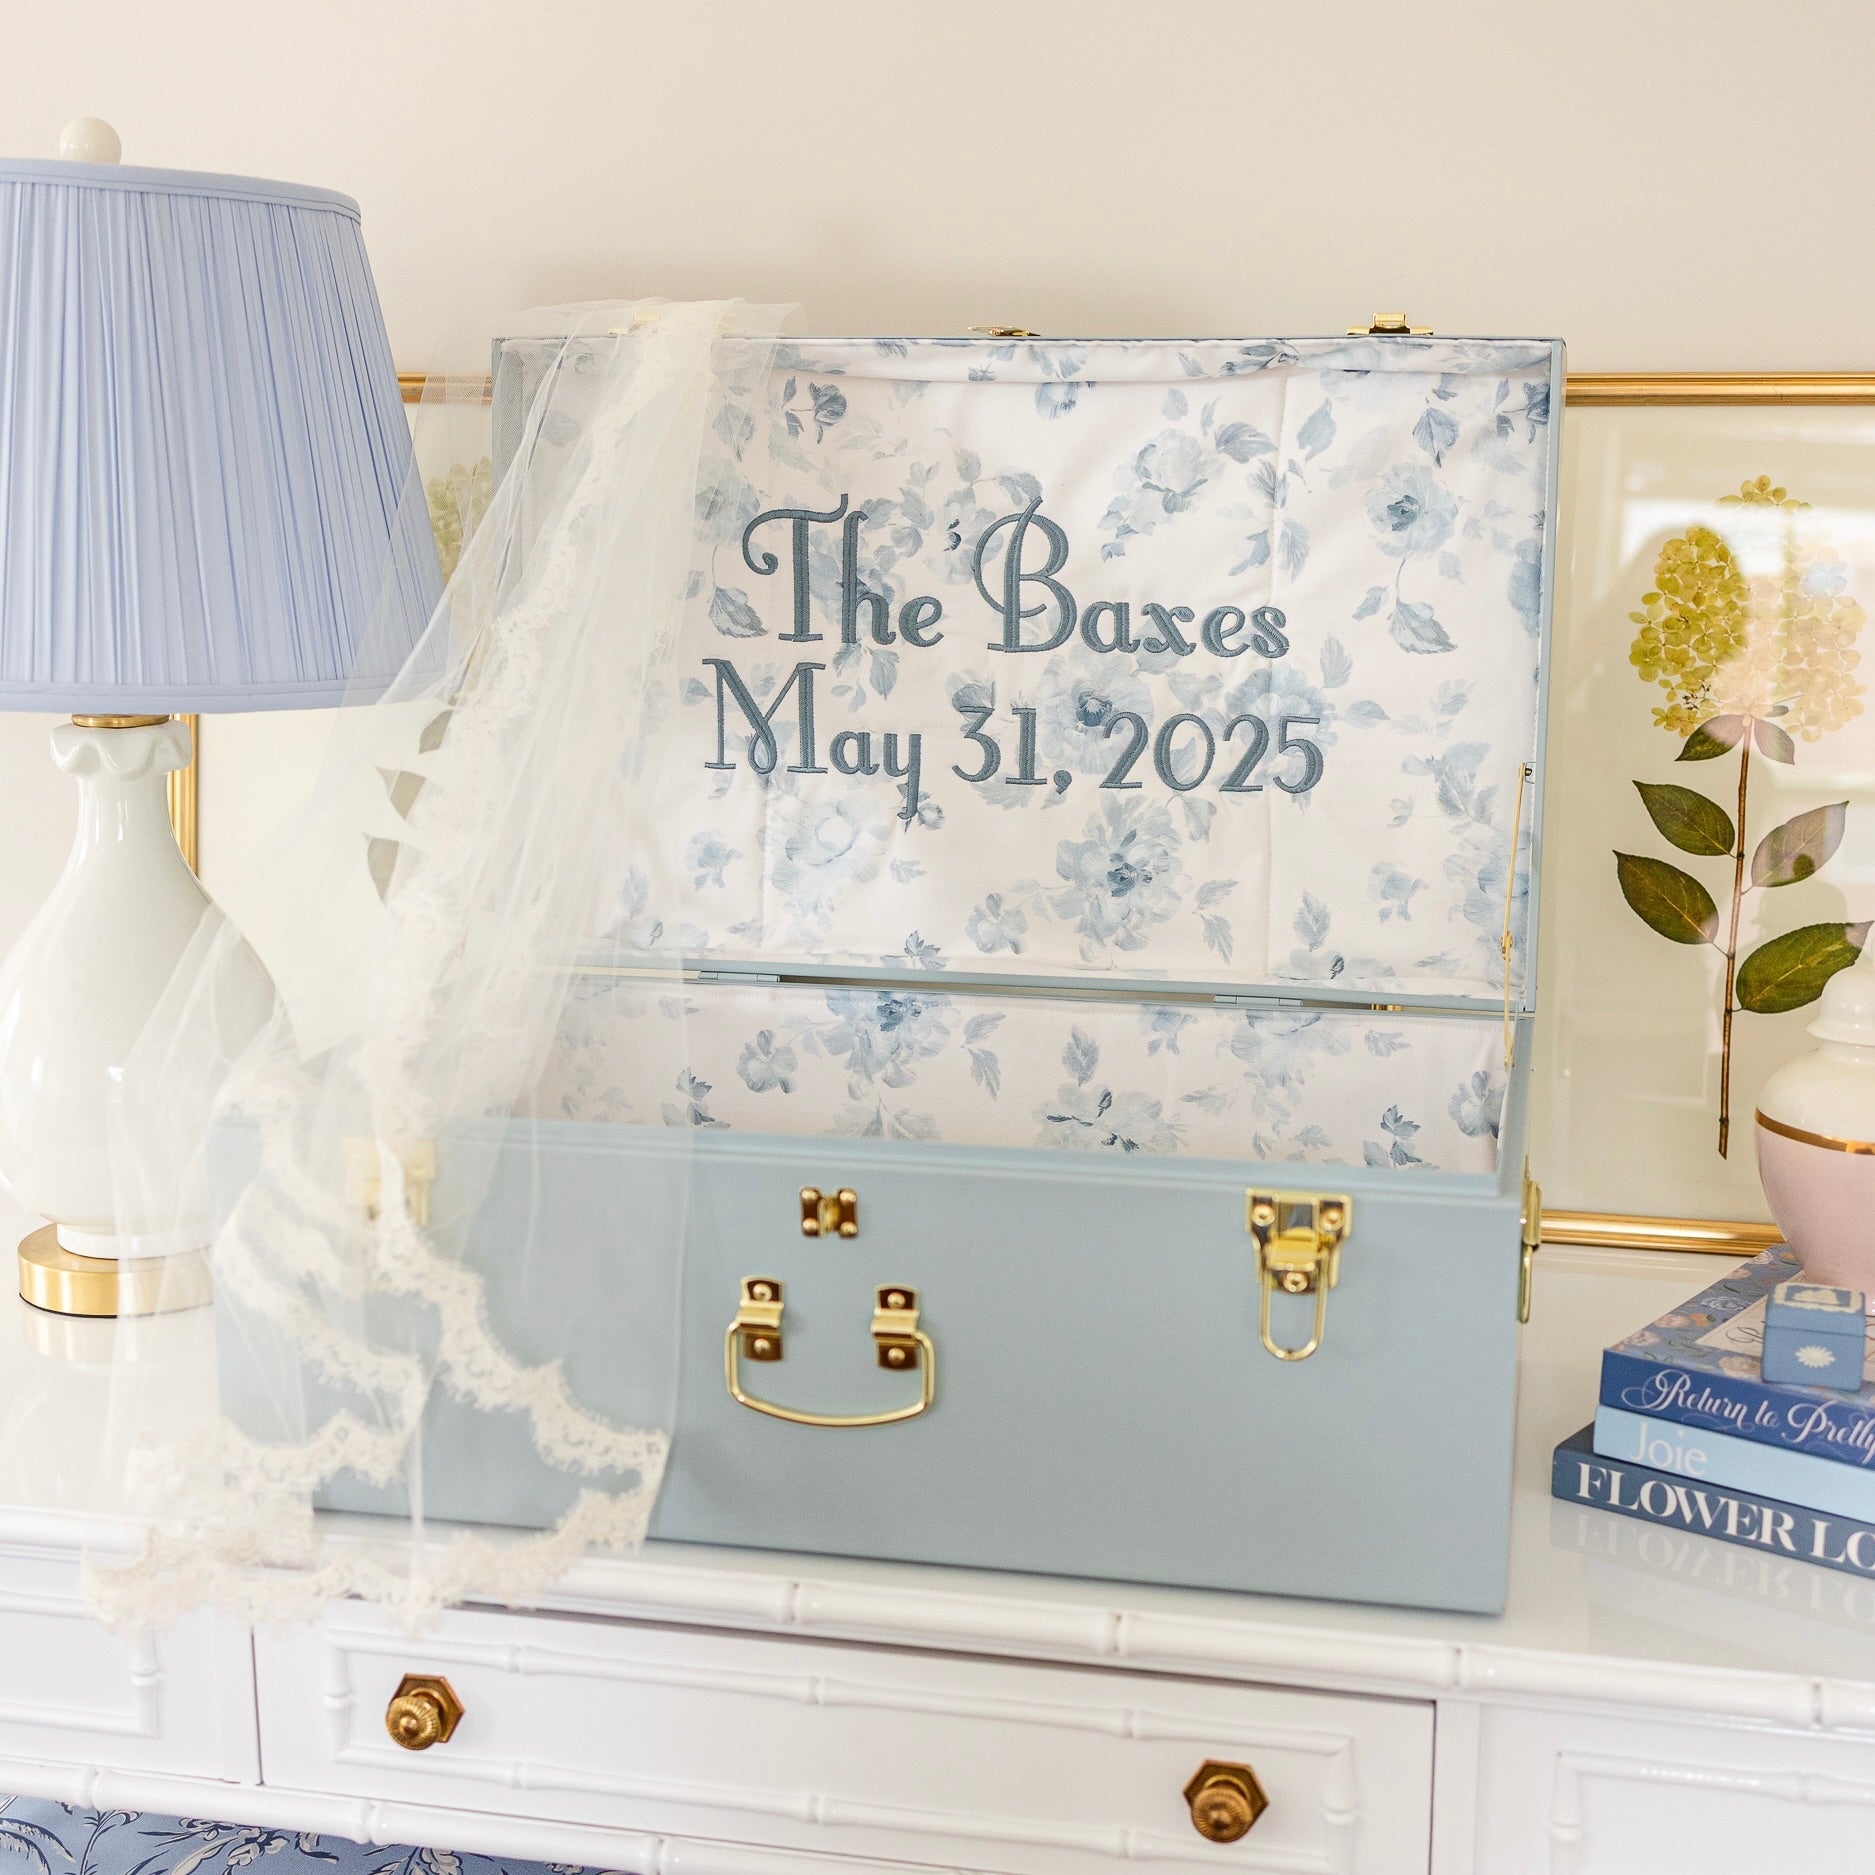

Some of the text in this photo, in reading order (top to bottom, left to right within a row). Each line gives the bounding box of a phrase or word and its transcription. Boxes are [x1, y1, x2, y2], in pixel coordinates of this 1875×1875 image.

[742, 493, 1290, 659] The Baxes
[702, 658, 1325, 819] May 31, 2025
[1622, 1369, 1747, 1430] Return
[1755, 1399, 1779, 1428] to
[1628, 1421, 1707, 1476] Joie
[1576, 1461, 1797, 1551] FLOWER
